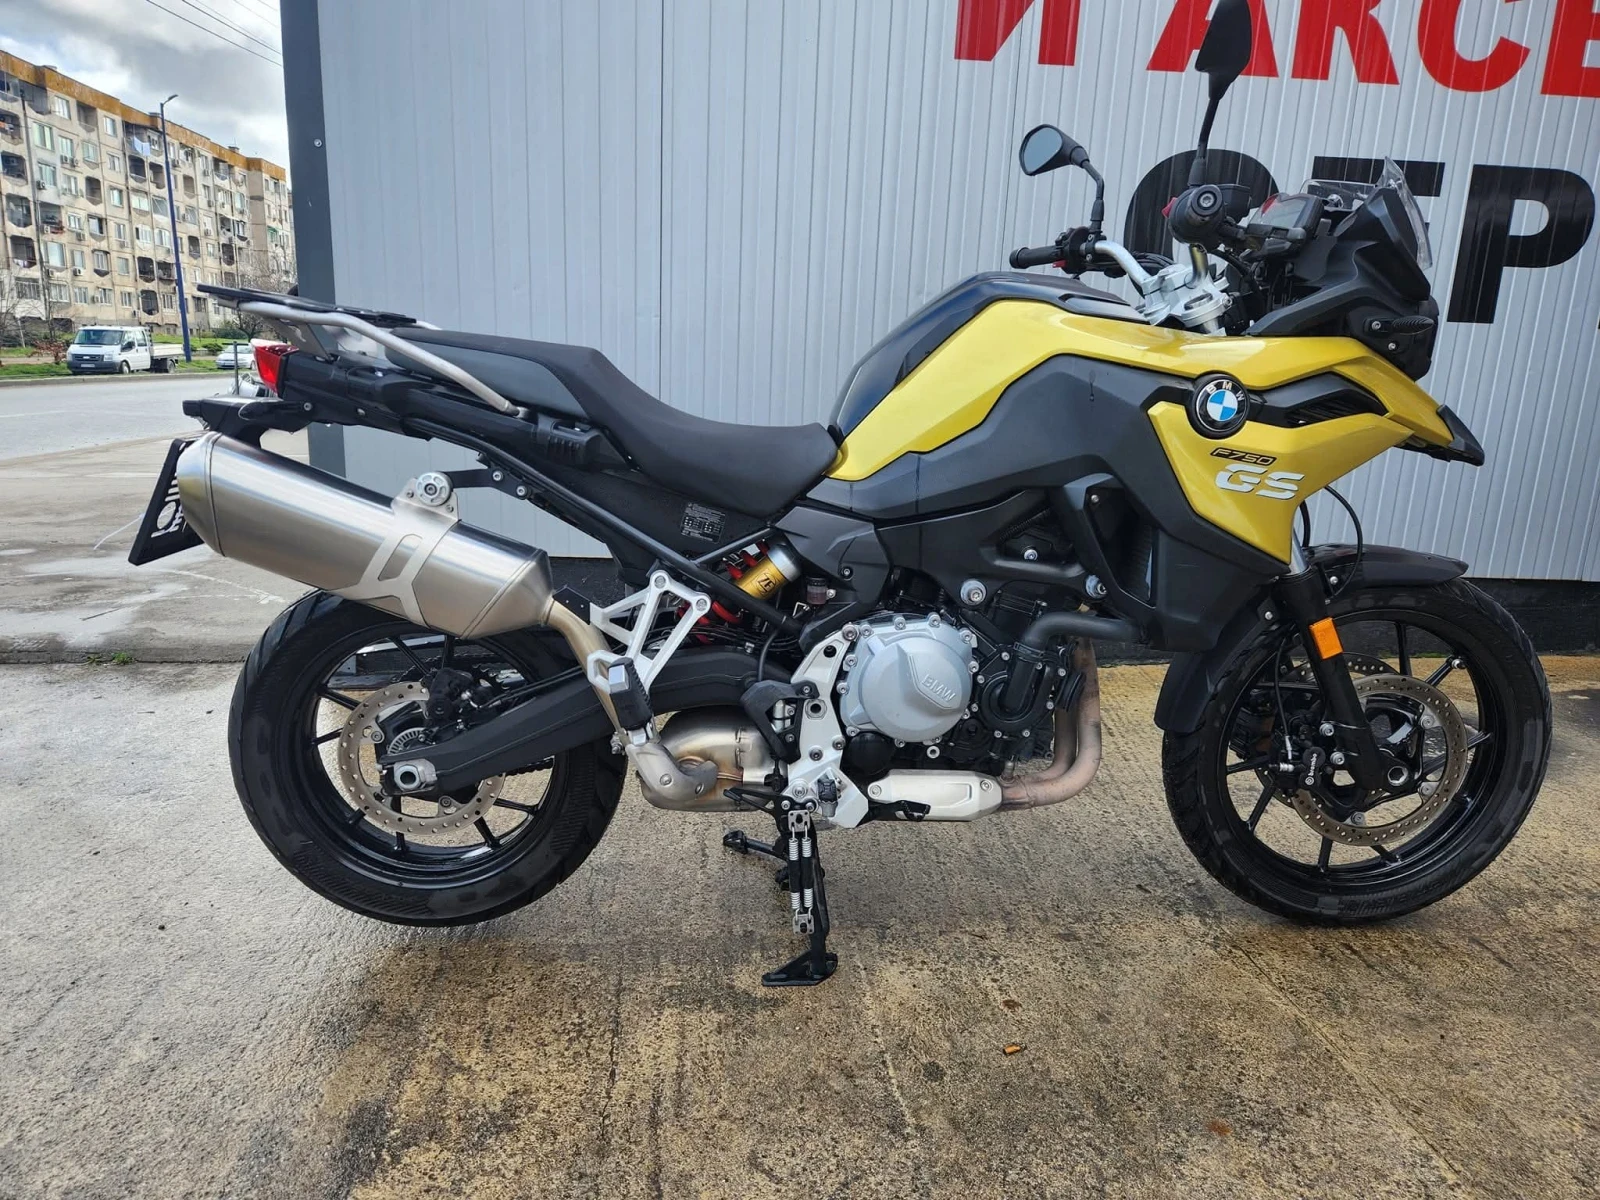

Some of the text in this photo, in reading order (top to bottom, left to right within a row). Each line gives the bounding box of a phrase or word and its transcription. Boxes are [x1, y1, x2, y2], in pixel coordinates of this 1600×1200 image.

[1205, 379, 1245, 402] BMW
[1212, 448, 1274, 465] F750
[1215, 463, 1305, 500] GS
[921, 673, 957, 702] BMW
[1307, 752, 1318, 777] brembo
